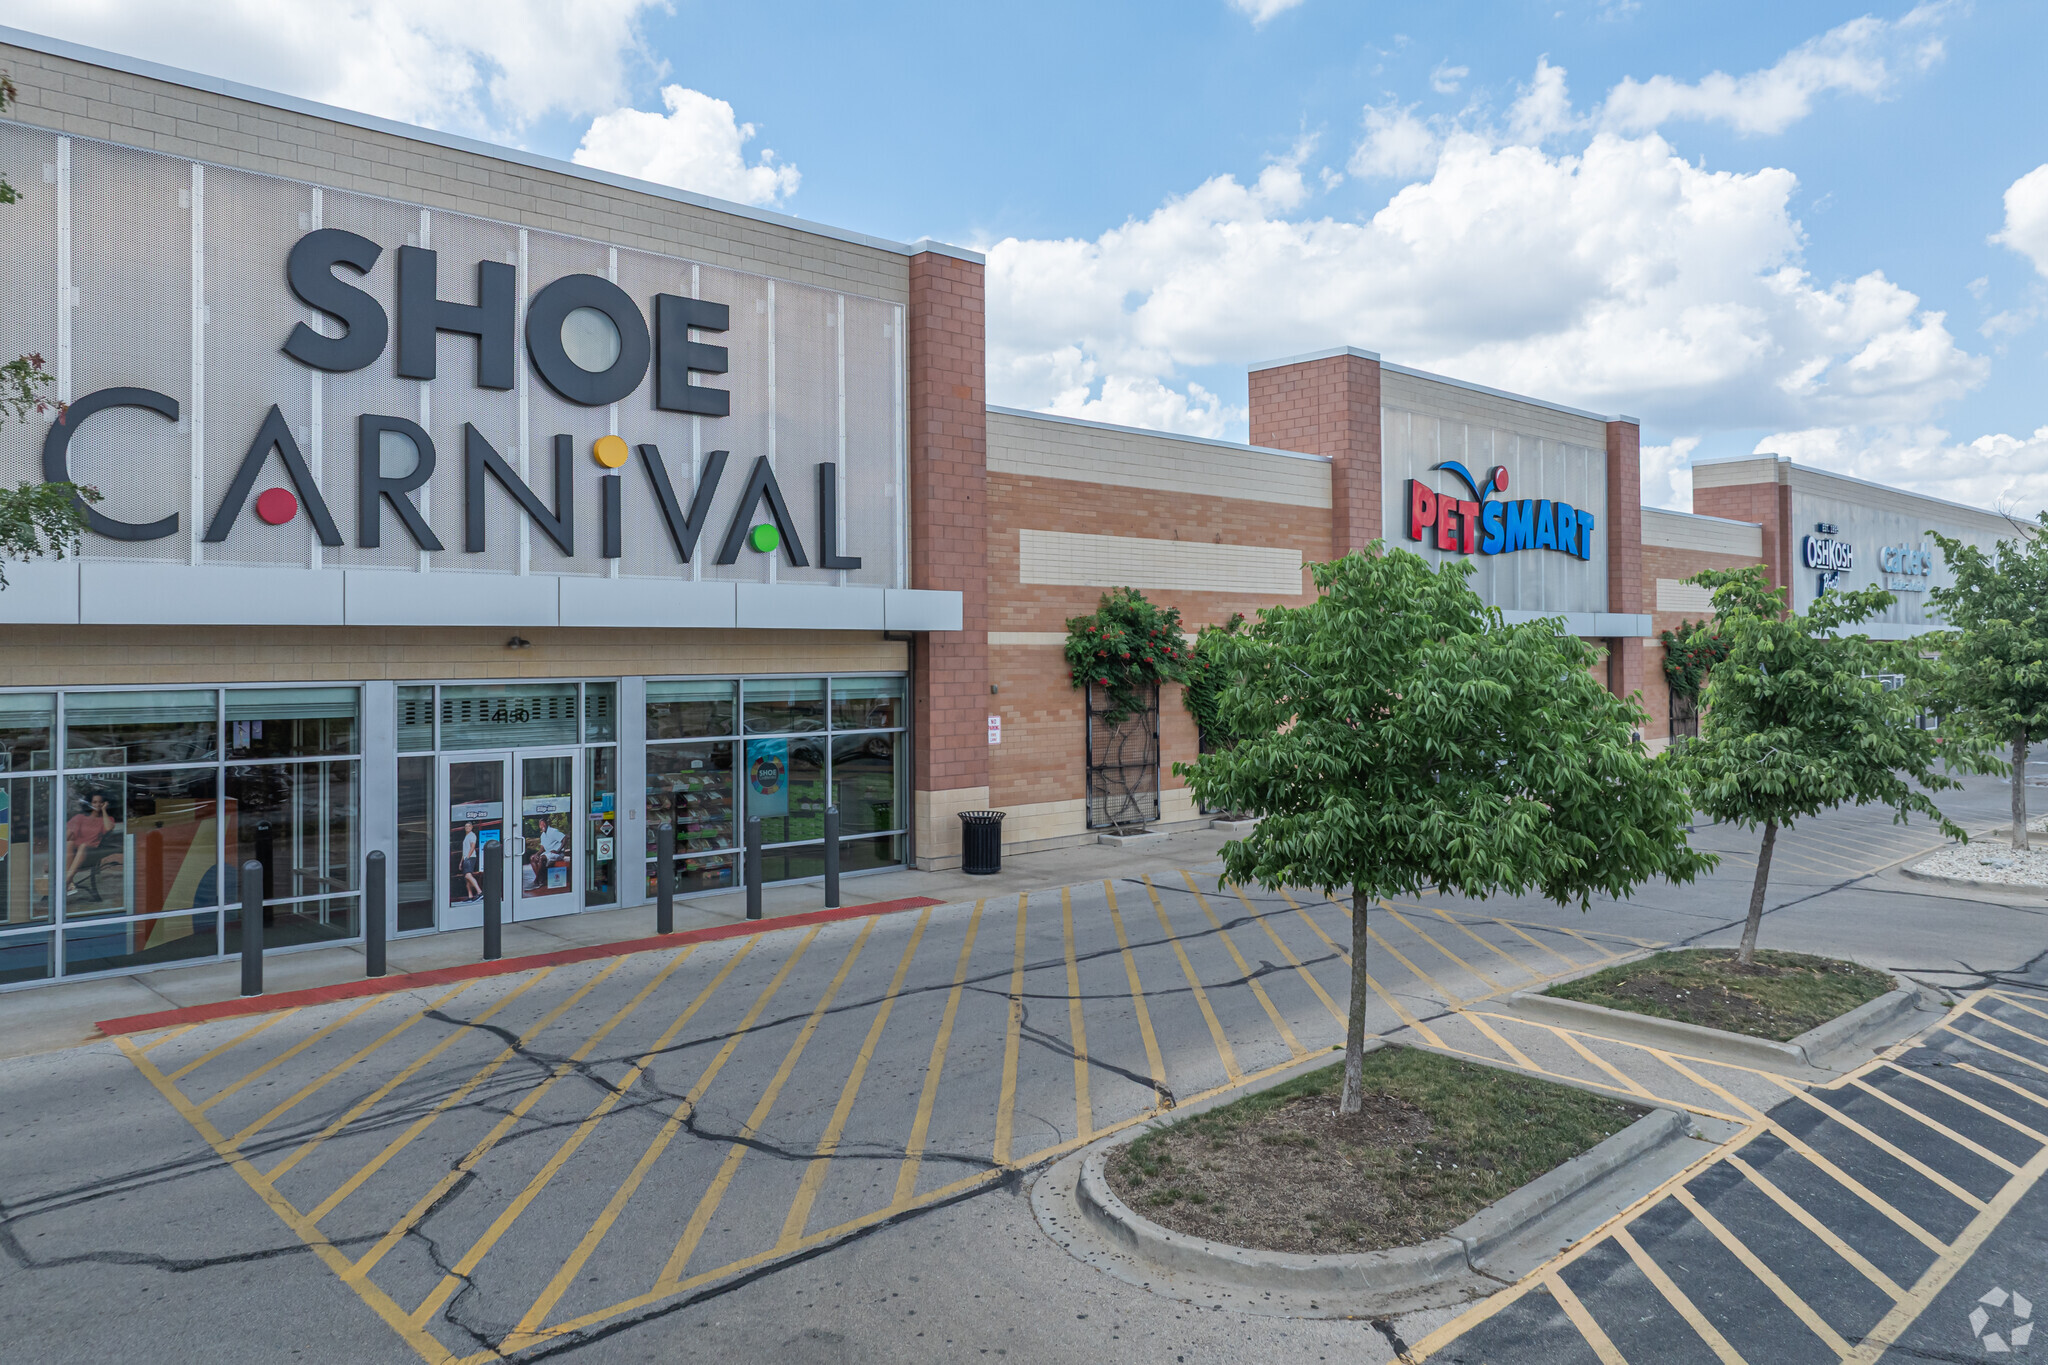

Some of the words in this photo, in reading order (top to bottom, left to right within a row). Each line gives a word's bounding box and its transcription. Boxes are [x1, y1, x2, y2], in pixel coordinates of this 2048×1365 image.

[281, 228, 730, 417] SHOE
[1882, 542, 1932, 577] carter's
[491, 708, 530, 724] 4150
[759, 768, 777, 777] SHOE
